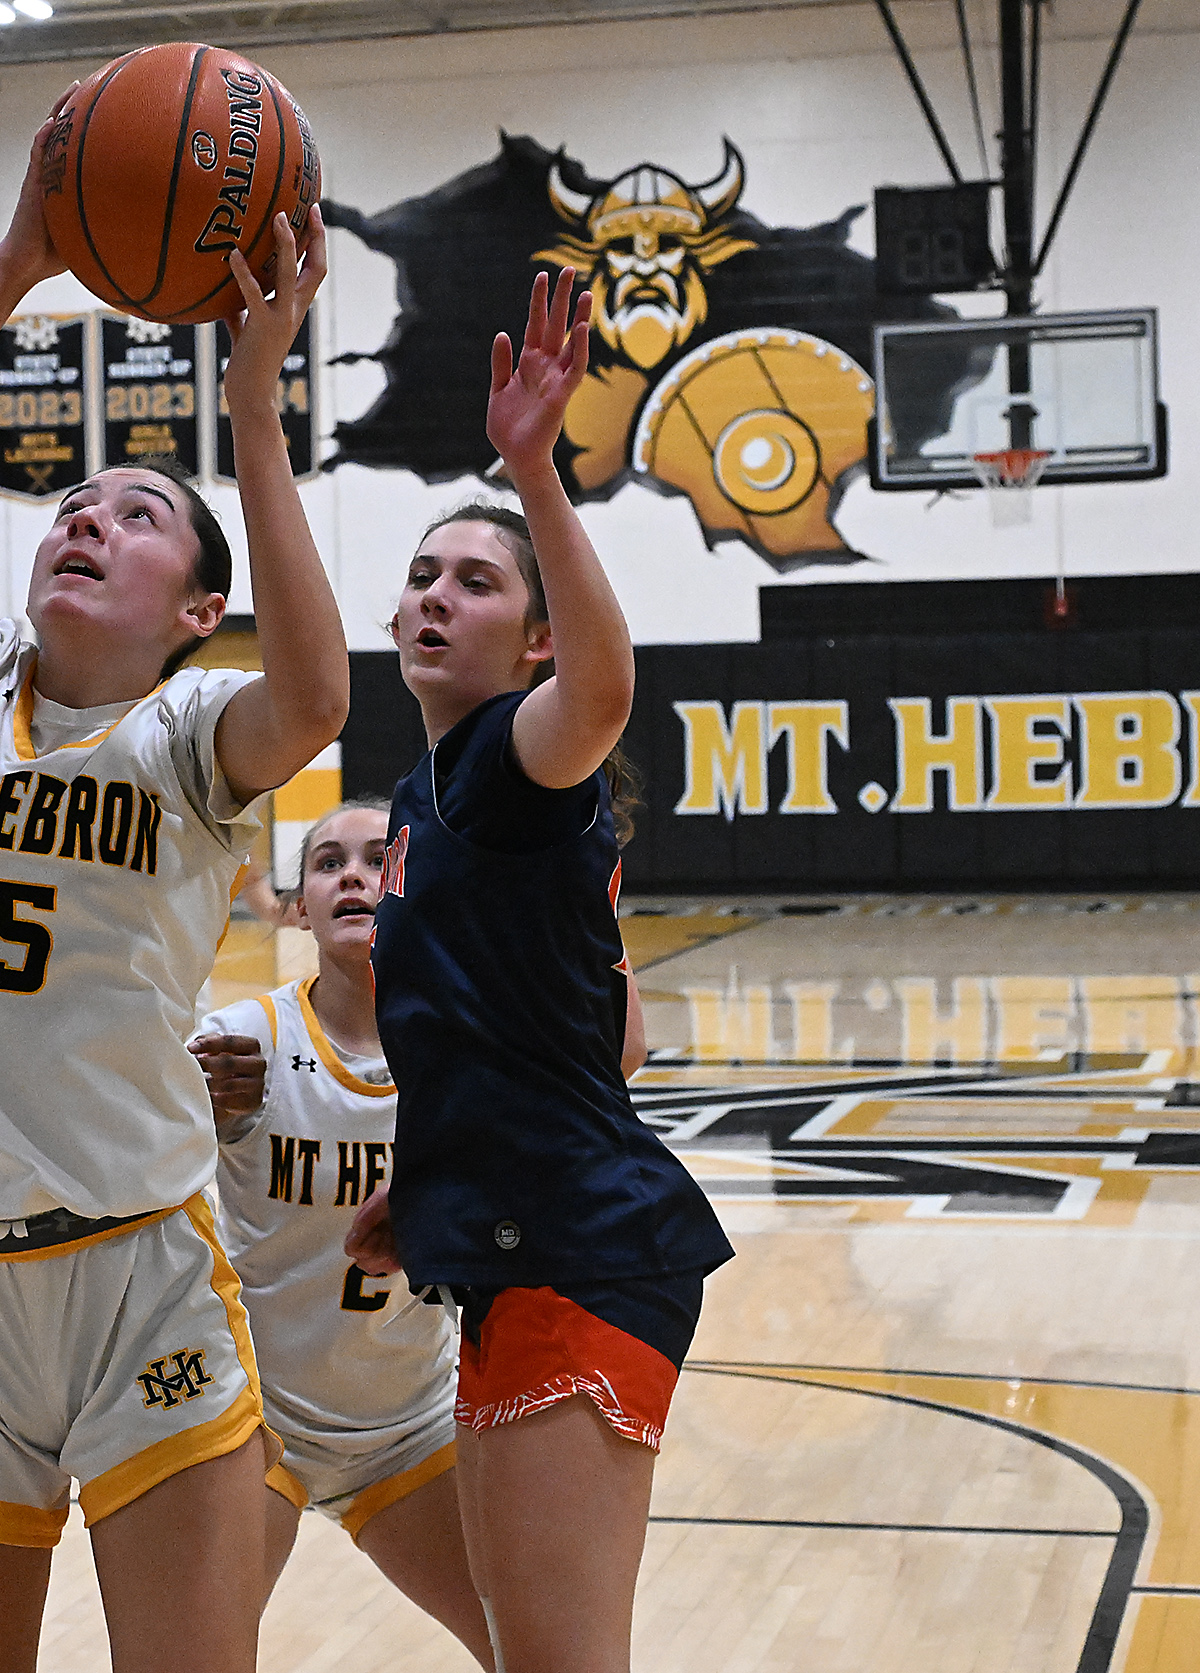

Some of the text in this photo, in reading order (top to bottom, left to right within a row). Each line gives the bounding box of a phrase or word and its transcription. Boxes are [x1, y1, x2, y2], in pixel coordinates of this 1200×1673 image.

[193, 68, 264, 263] SPALDING
[107, 382, 195, 420] 2023
[267, 1134, 395, 1207] MT HE
